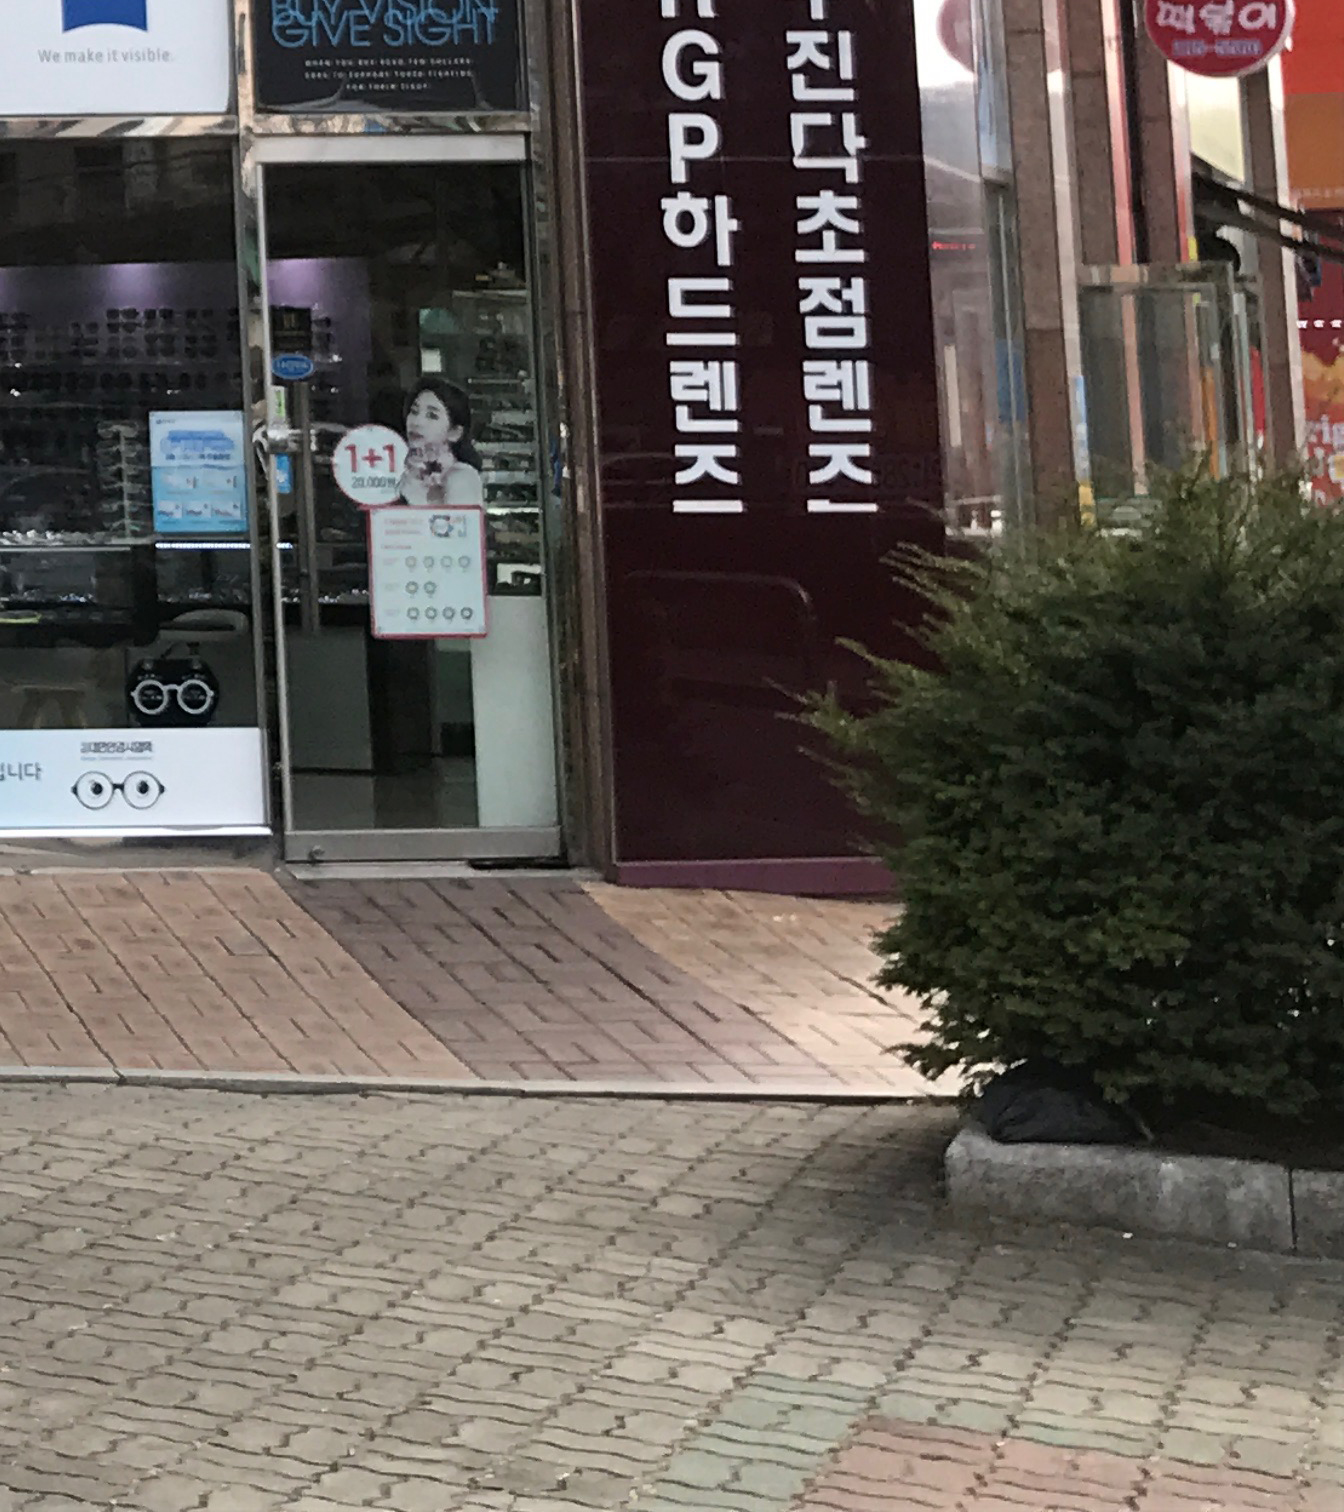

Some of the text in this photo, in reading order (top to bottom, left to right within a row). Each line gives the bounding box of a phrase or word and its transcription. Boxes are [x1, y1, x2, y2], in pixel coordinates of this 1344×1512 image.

[272, 7, 499, 48] GIVE SIGHT
[38, 49, 61, 63] We
[65, 48, 103, 63] make
[107, 48, 118, 63] it
[345, 444, 396, 473] 1+1
